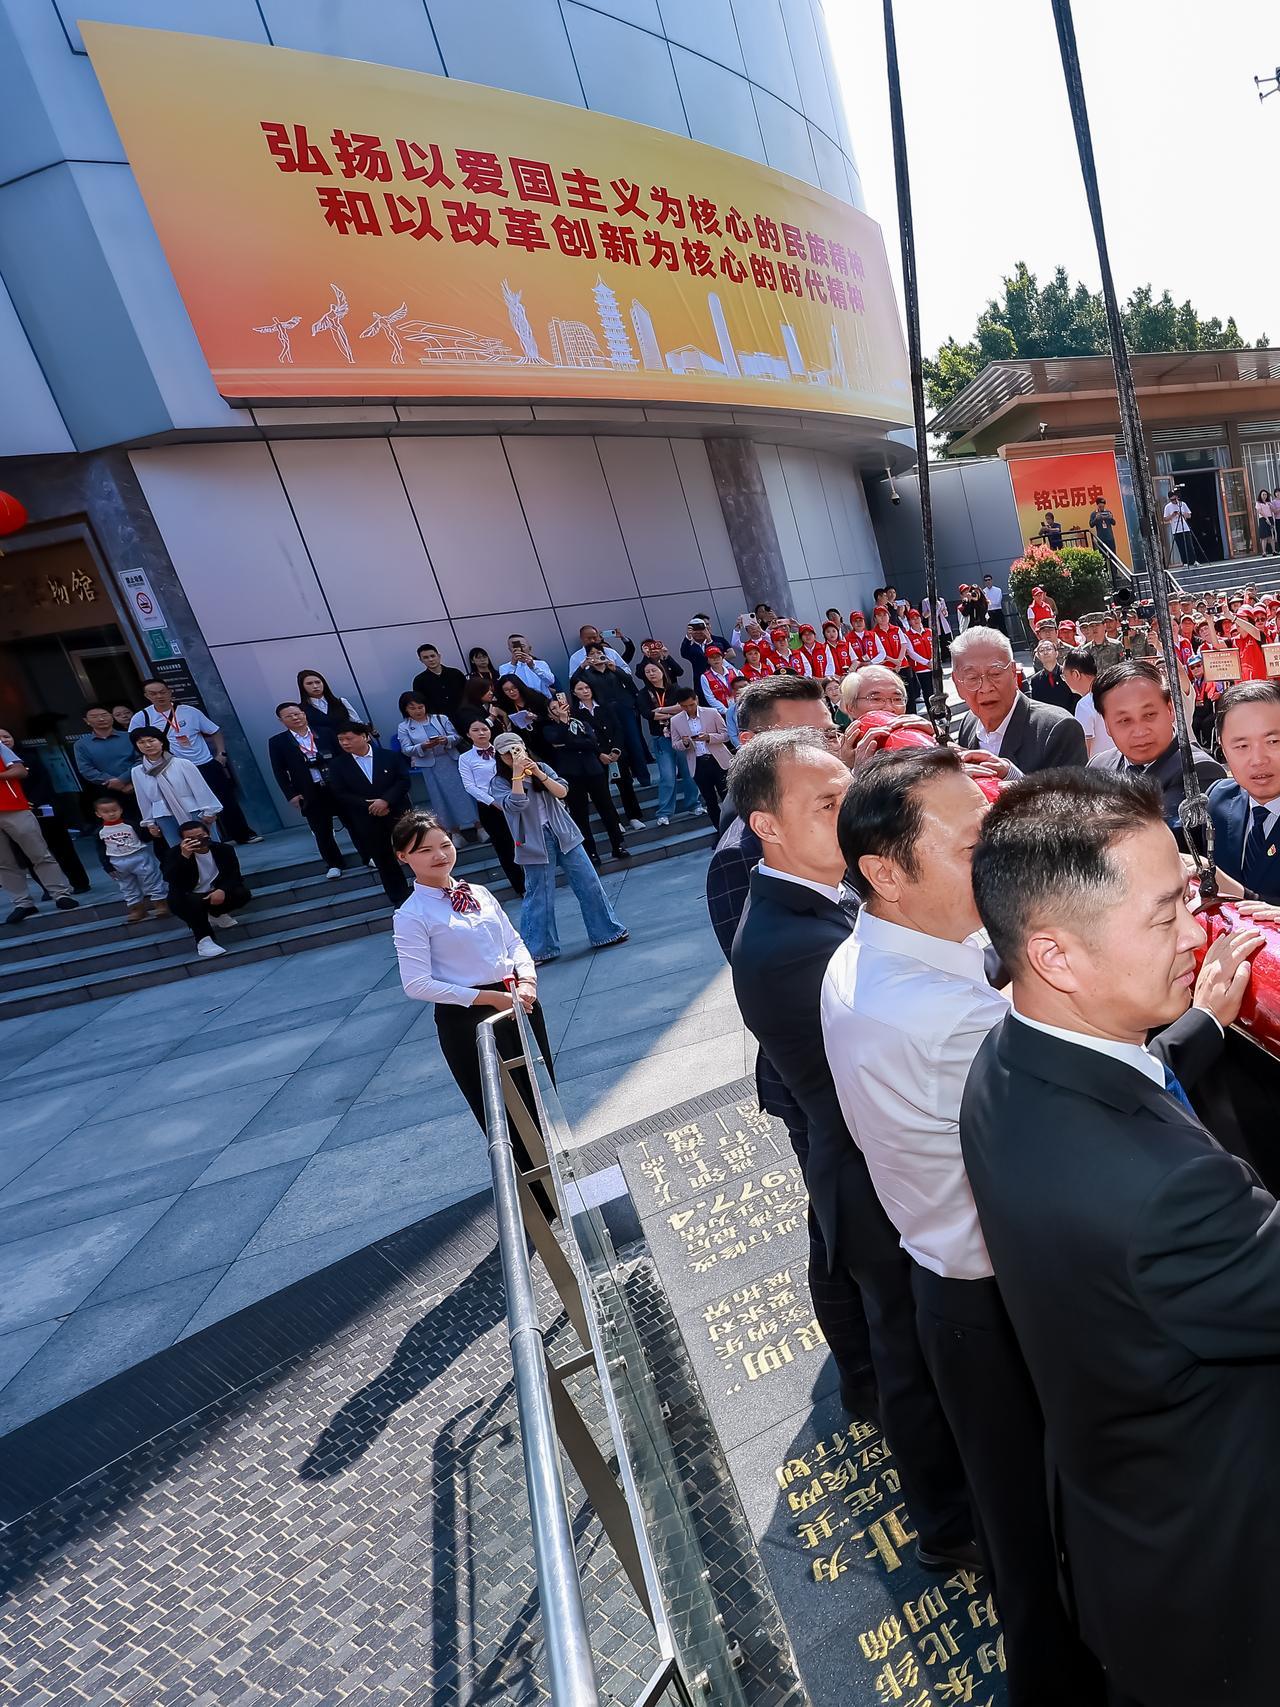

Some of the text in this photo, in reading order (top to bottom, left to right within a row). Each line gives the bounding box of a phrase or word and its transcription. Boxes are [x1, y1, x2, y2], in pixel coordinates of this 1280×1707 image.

[260, 121, 865, 282] 弘扬以爱国主义为核心的民族精神
[316, 187, 865, 315] 和以改革创新为核心的时代精神
[1034, 485, 1103, 511] 铭记历史
[684, 1212, 809, 1274] 进行修改，
